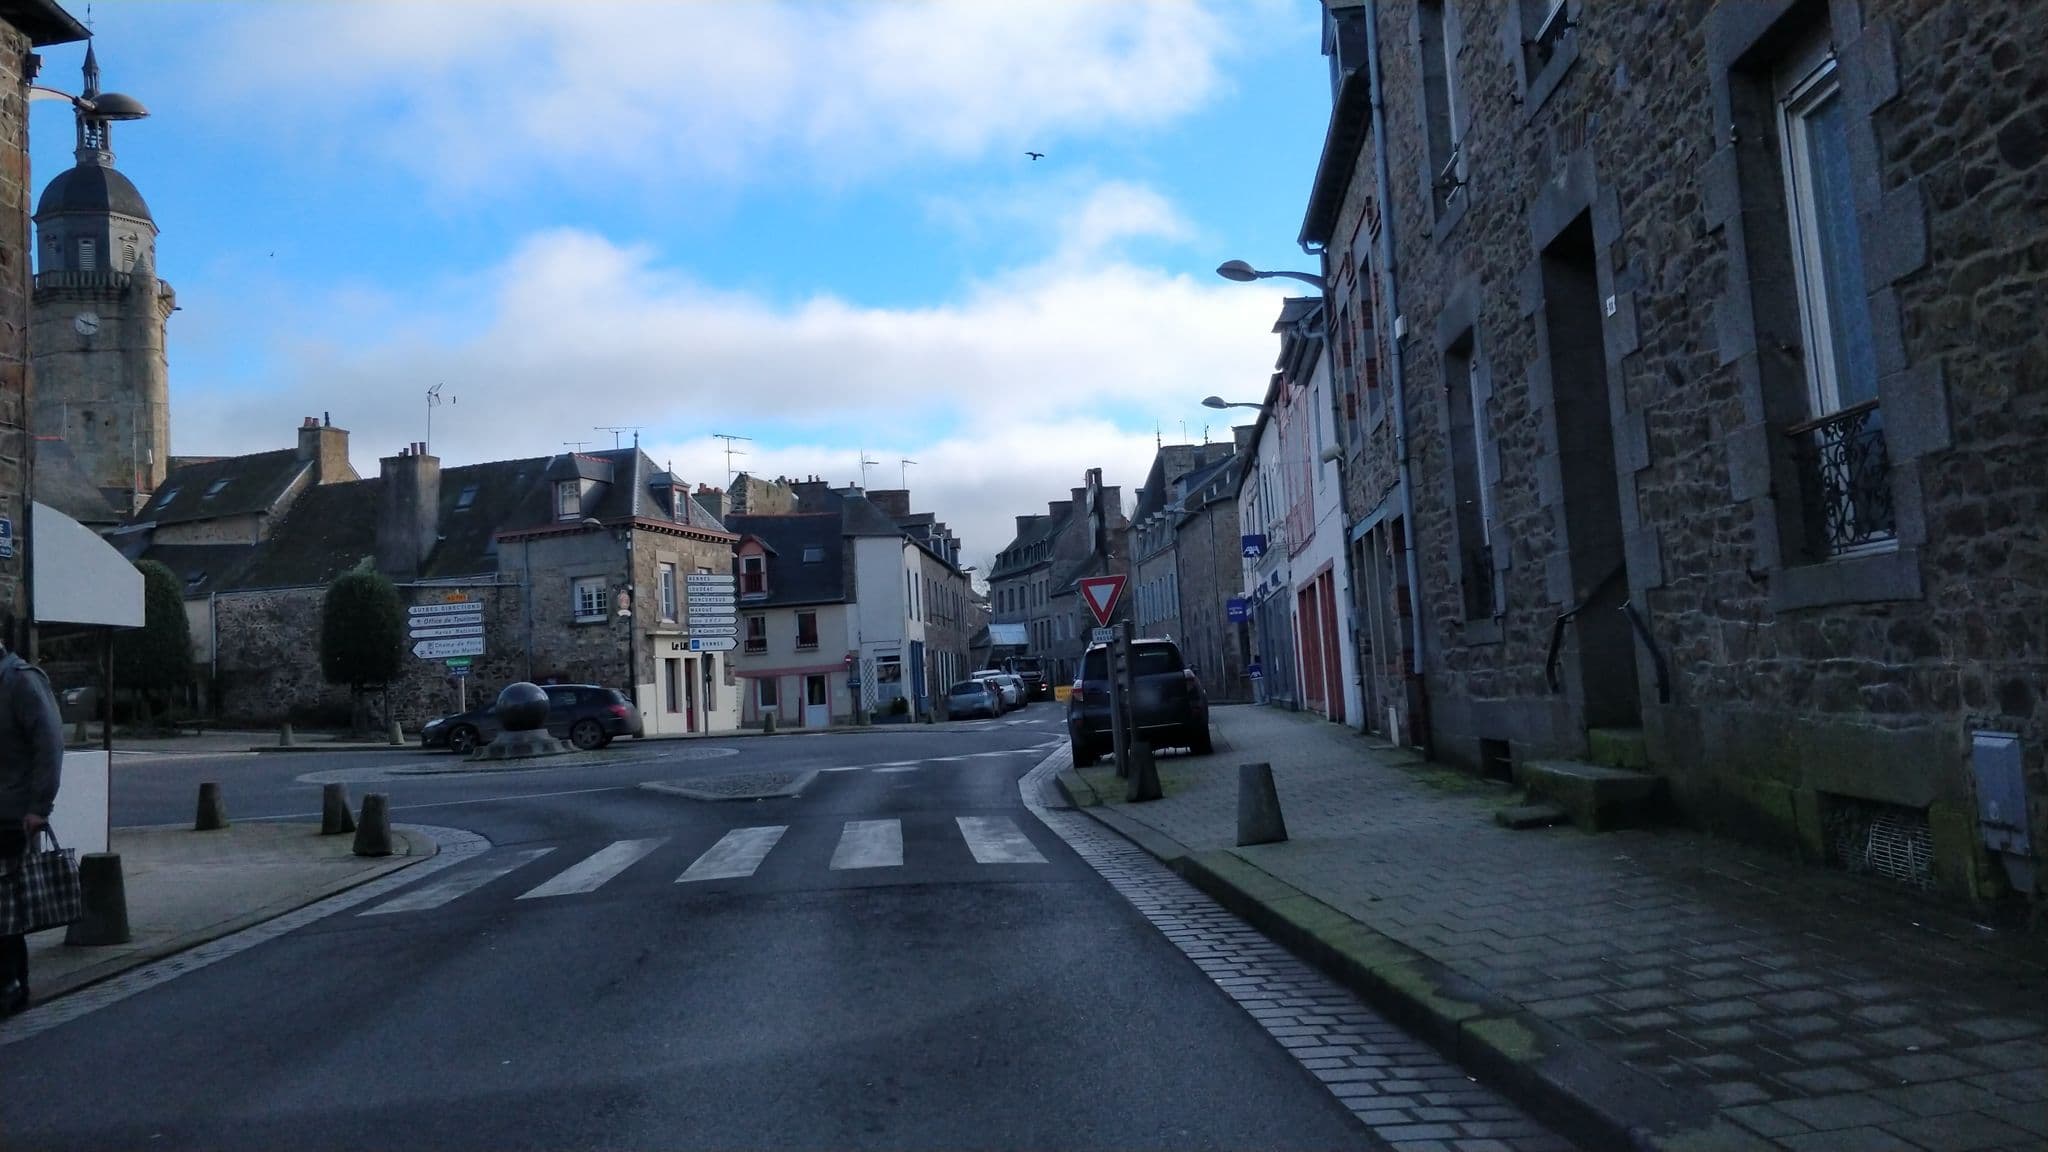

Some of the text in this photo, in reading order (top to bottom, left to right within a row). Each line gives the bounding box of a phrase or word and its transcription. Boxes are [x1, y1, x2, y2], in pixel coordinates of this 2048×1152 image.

[1243, 545, 1260, 554] AXA
[441, 603, 481, 611] DIRECTIONS
[423, 617, 442, 625] Office
